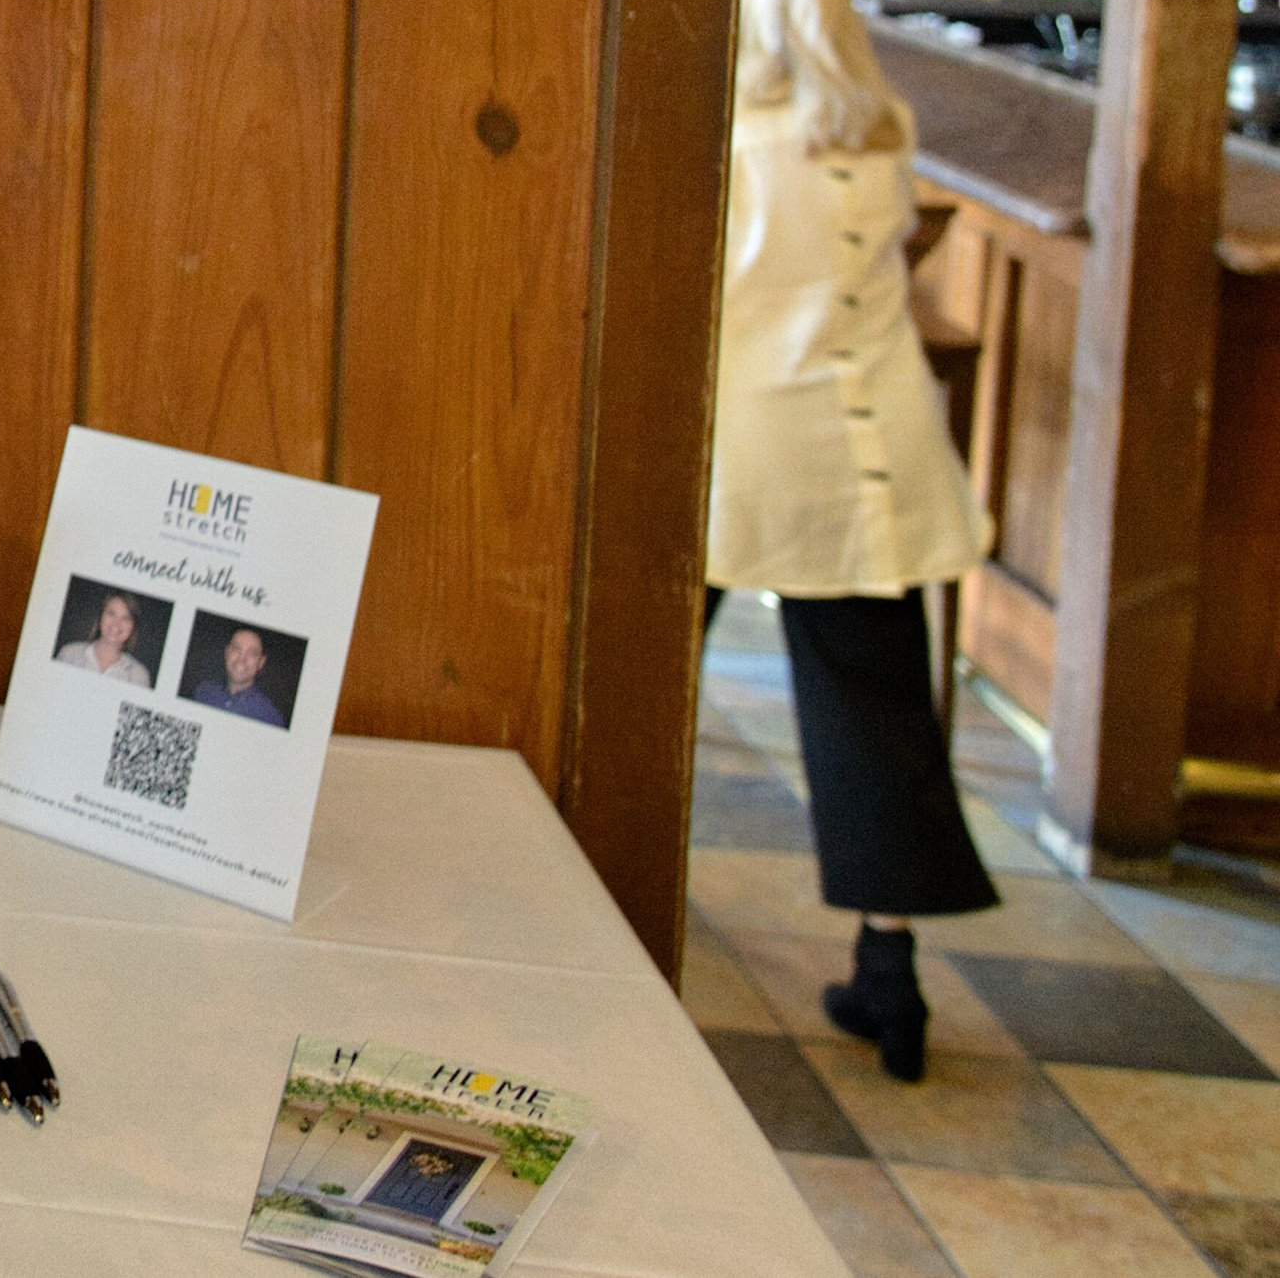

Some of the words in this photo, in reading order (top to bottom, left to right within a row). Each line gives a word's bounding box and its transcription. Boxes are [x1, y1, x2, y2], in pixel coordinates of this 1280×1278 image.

[163, 510, 248, 543] stretch
[113, 550, 187, 583] connect
[190, 564, 239, 597] with
[423, 1081, 547, 1120] stretch
